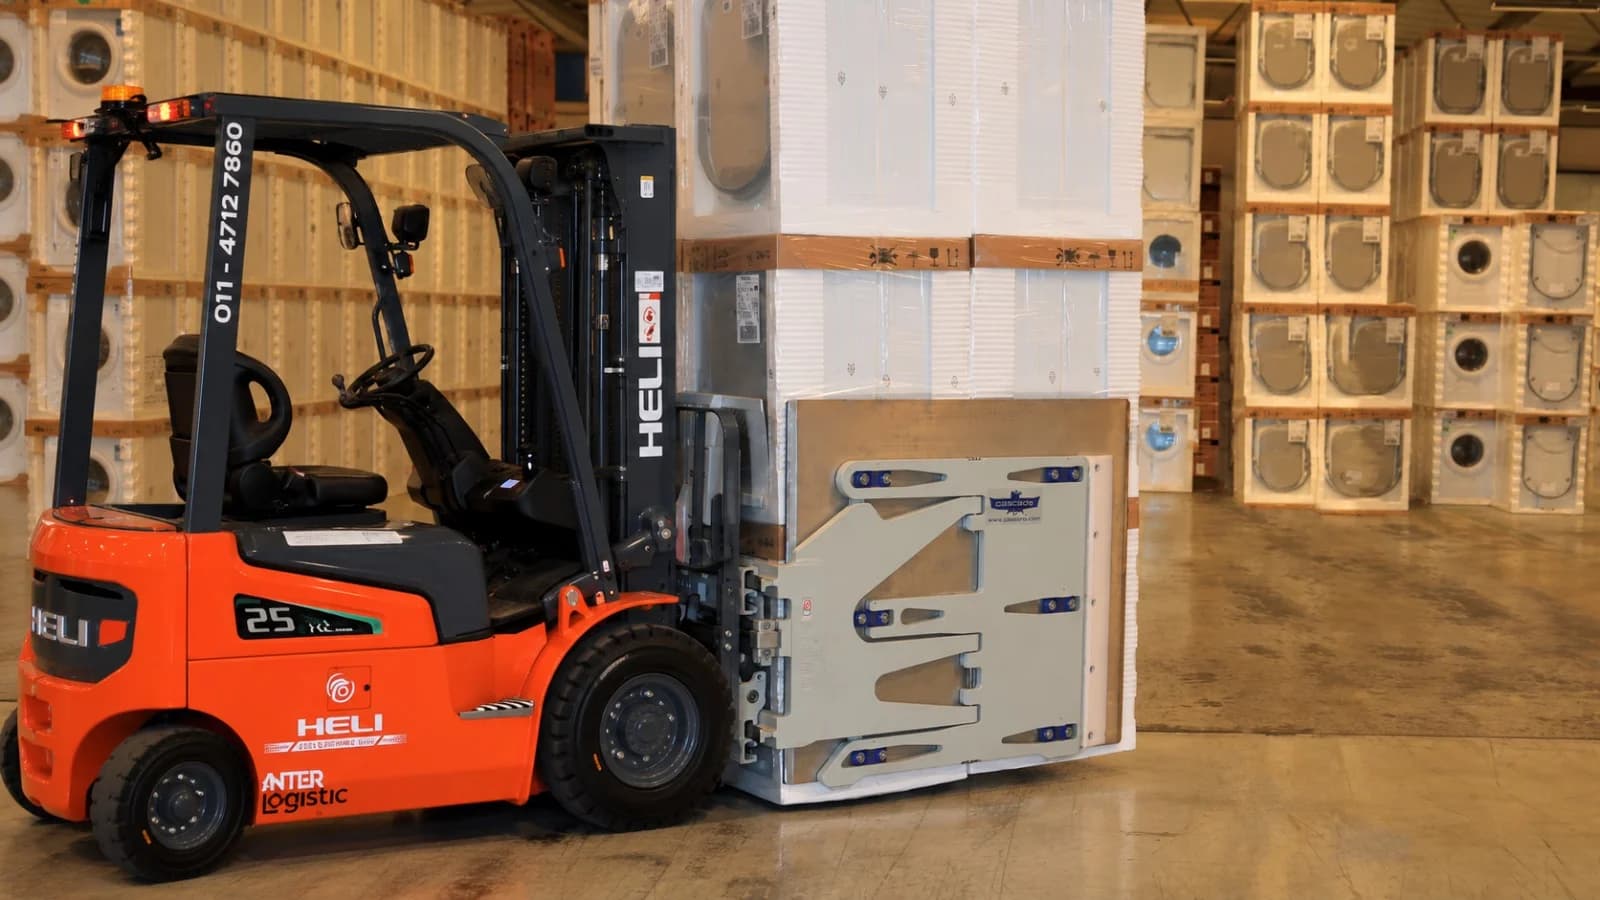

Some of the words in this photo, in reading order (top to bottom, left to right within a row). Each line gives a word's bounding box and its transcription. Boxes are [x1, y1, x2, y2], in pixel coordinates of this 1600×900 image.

[223, 121, 243, 187] 7860
[219, 194, 239, 256] 4712
[224, 262, 230, 274] -
[214, 280, 234, 324] 011
[638, 345, 663, 457] HELI
[31, 605, 88, 648] HELI
[244, 607, 296, 633] 25
[297, 713, 383, 737] HELI
[261, 769, 324, 792] ANTER
[262, 787, 348, 815] Logistic
